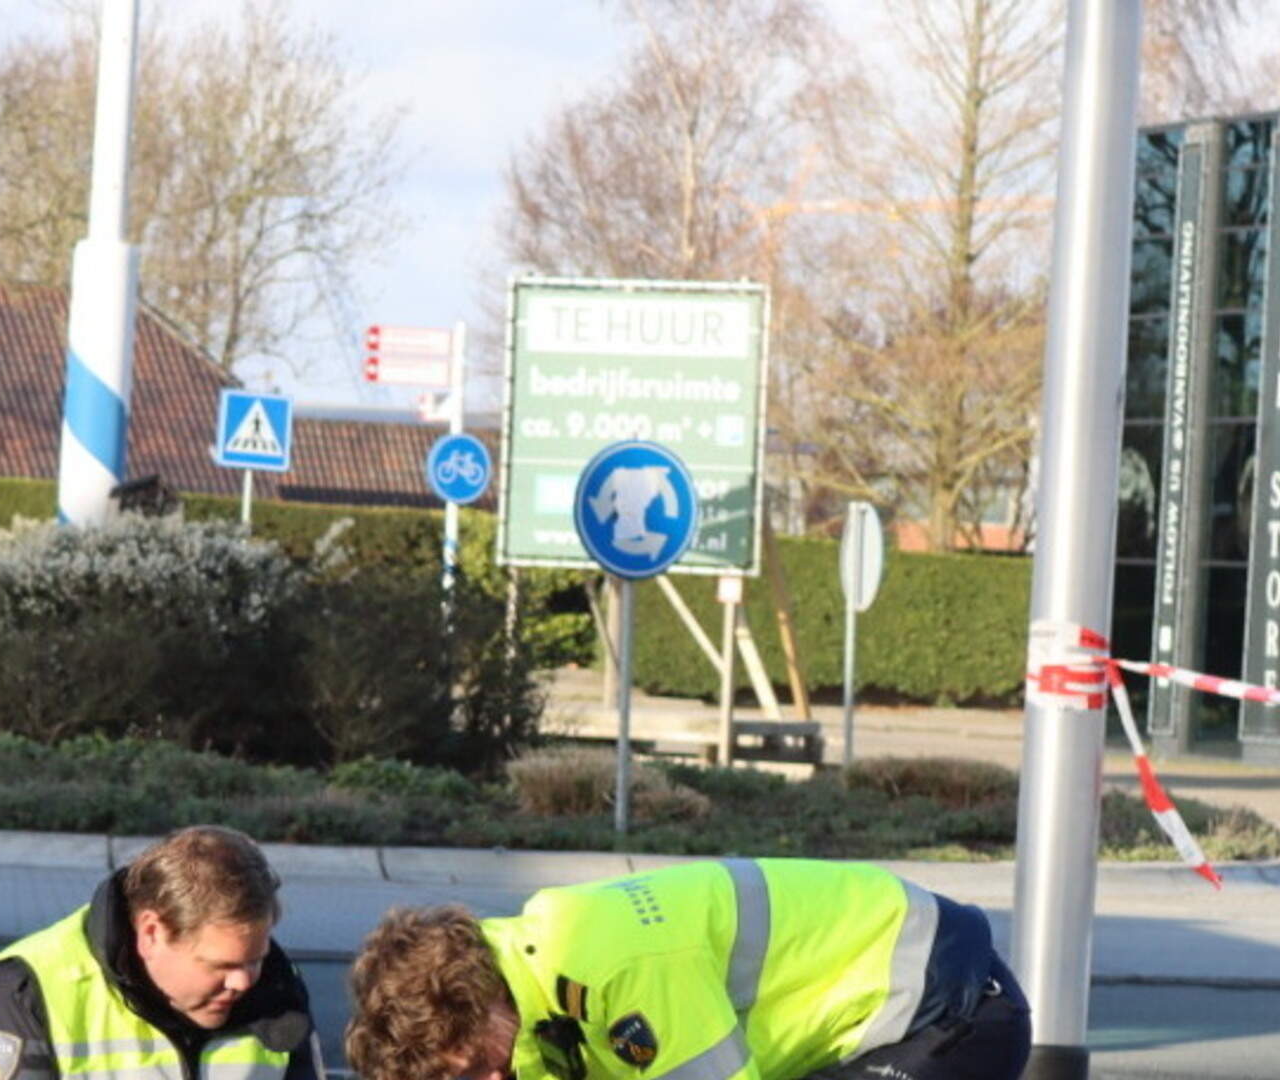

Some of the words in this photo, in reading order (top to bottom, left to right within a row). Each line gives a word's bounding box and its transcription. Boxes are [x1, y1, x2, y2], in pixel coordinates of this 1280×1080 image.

[552, 306, 590, 342] TE
[607, 306, 724, 345] HUUR
[529, 365, 740, 406] bedrijfsruimte
[1162, 501, 1179, 605] FOLLOW
